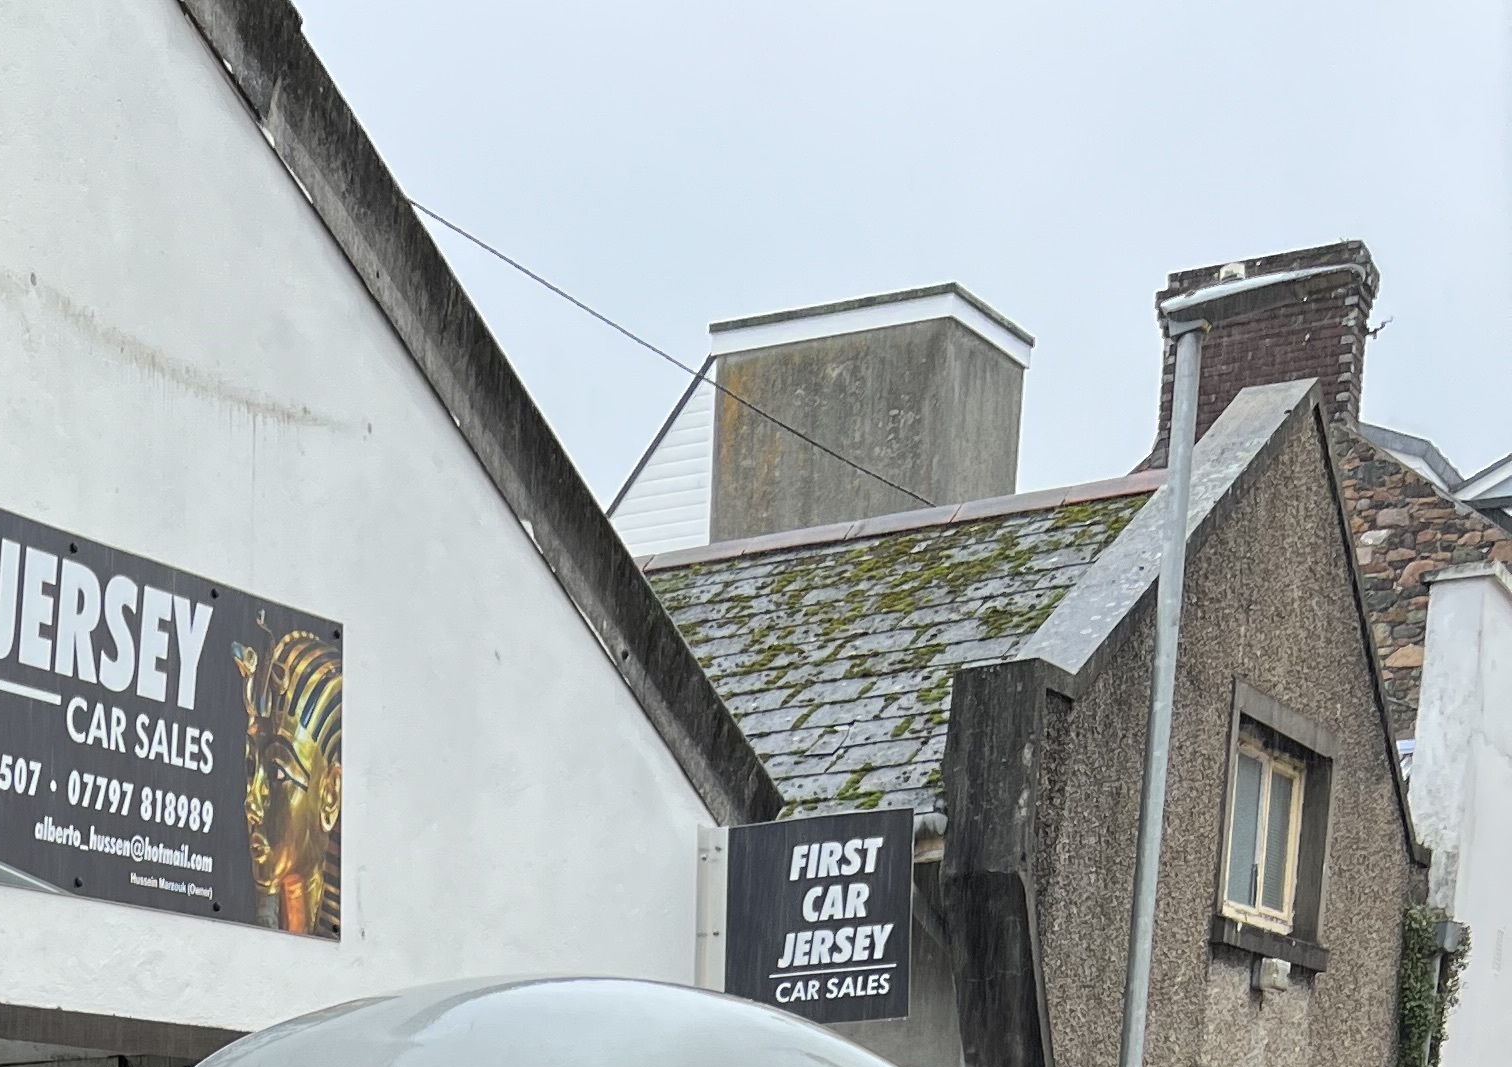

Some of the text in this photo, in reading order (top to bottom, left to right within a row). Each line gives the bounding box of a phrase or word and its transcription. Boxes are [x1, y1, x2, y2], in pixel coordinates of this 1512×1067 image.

[66, 696, 214, 775] CAR SALES
[67, 770, 134, 816] 07797
[140, 786, 214, 834] 818989
[34, 816, 213, 873] alberto_hussen@hotmail.com
[789, 837, 884, 881] FIRST
[129, 872, 157, 889] Hussein
[802, 883, 870, 923] CAR
[777, 923, 894, 969] JERSEY
[775, 973, 890, 1004] CAR SALES
